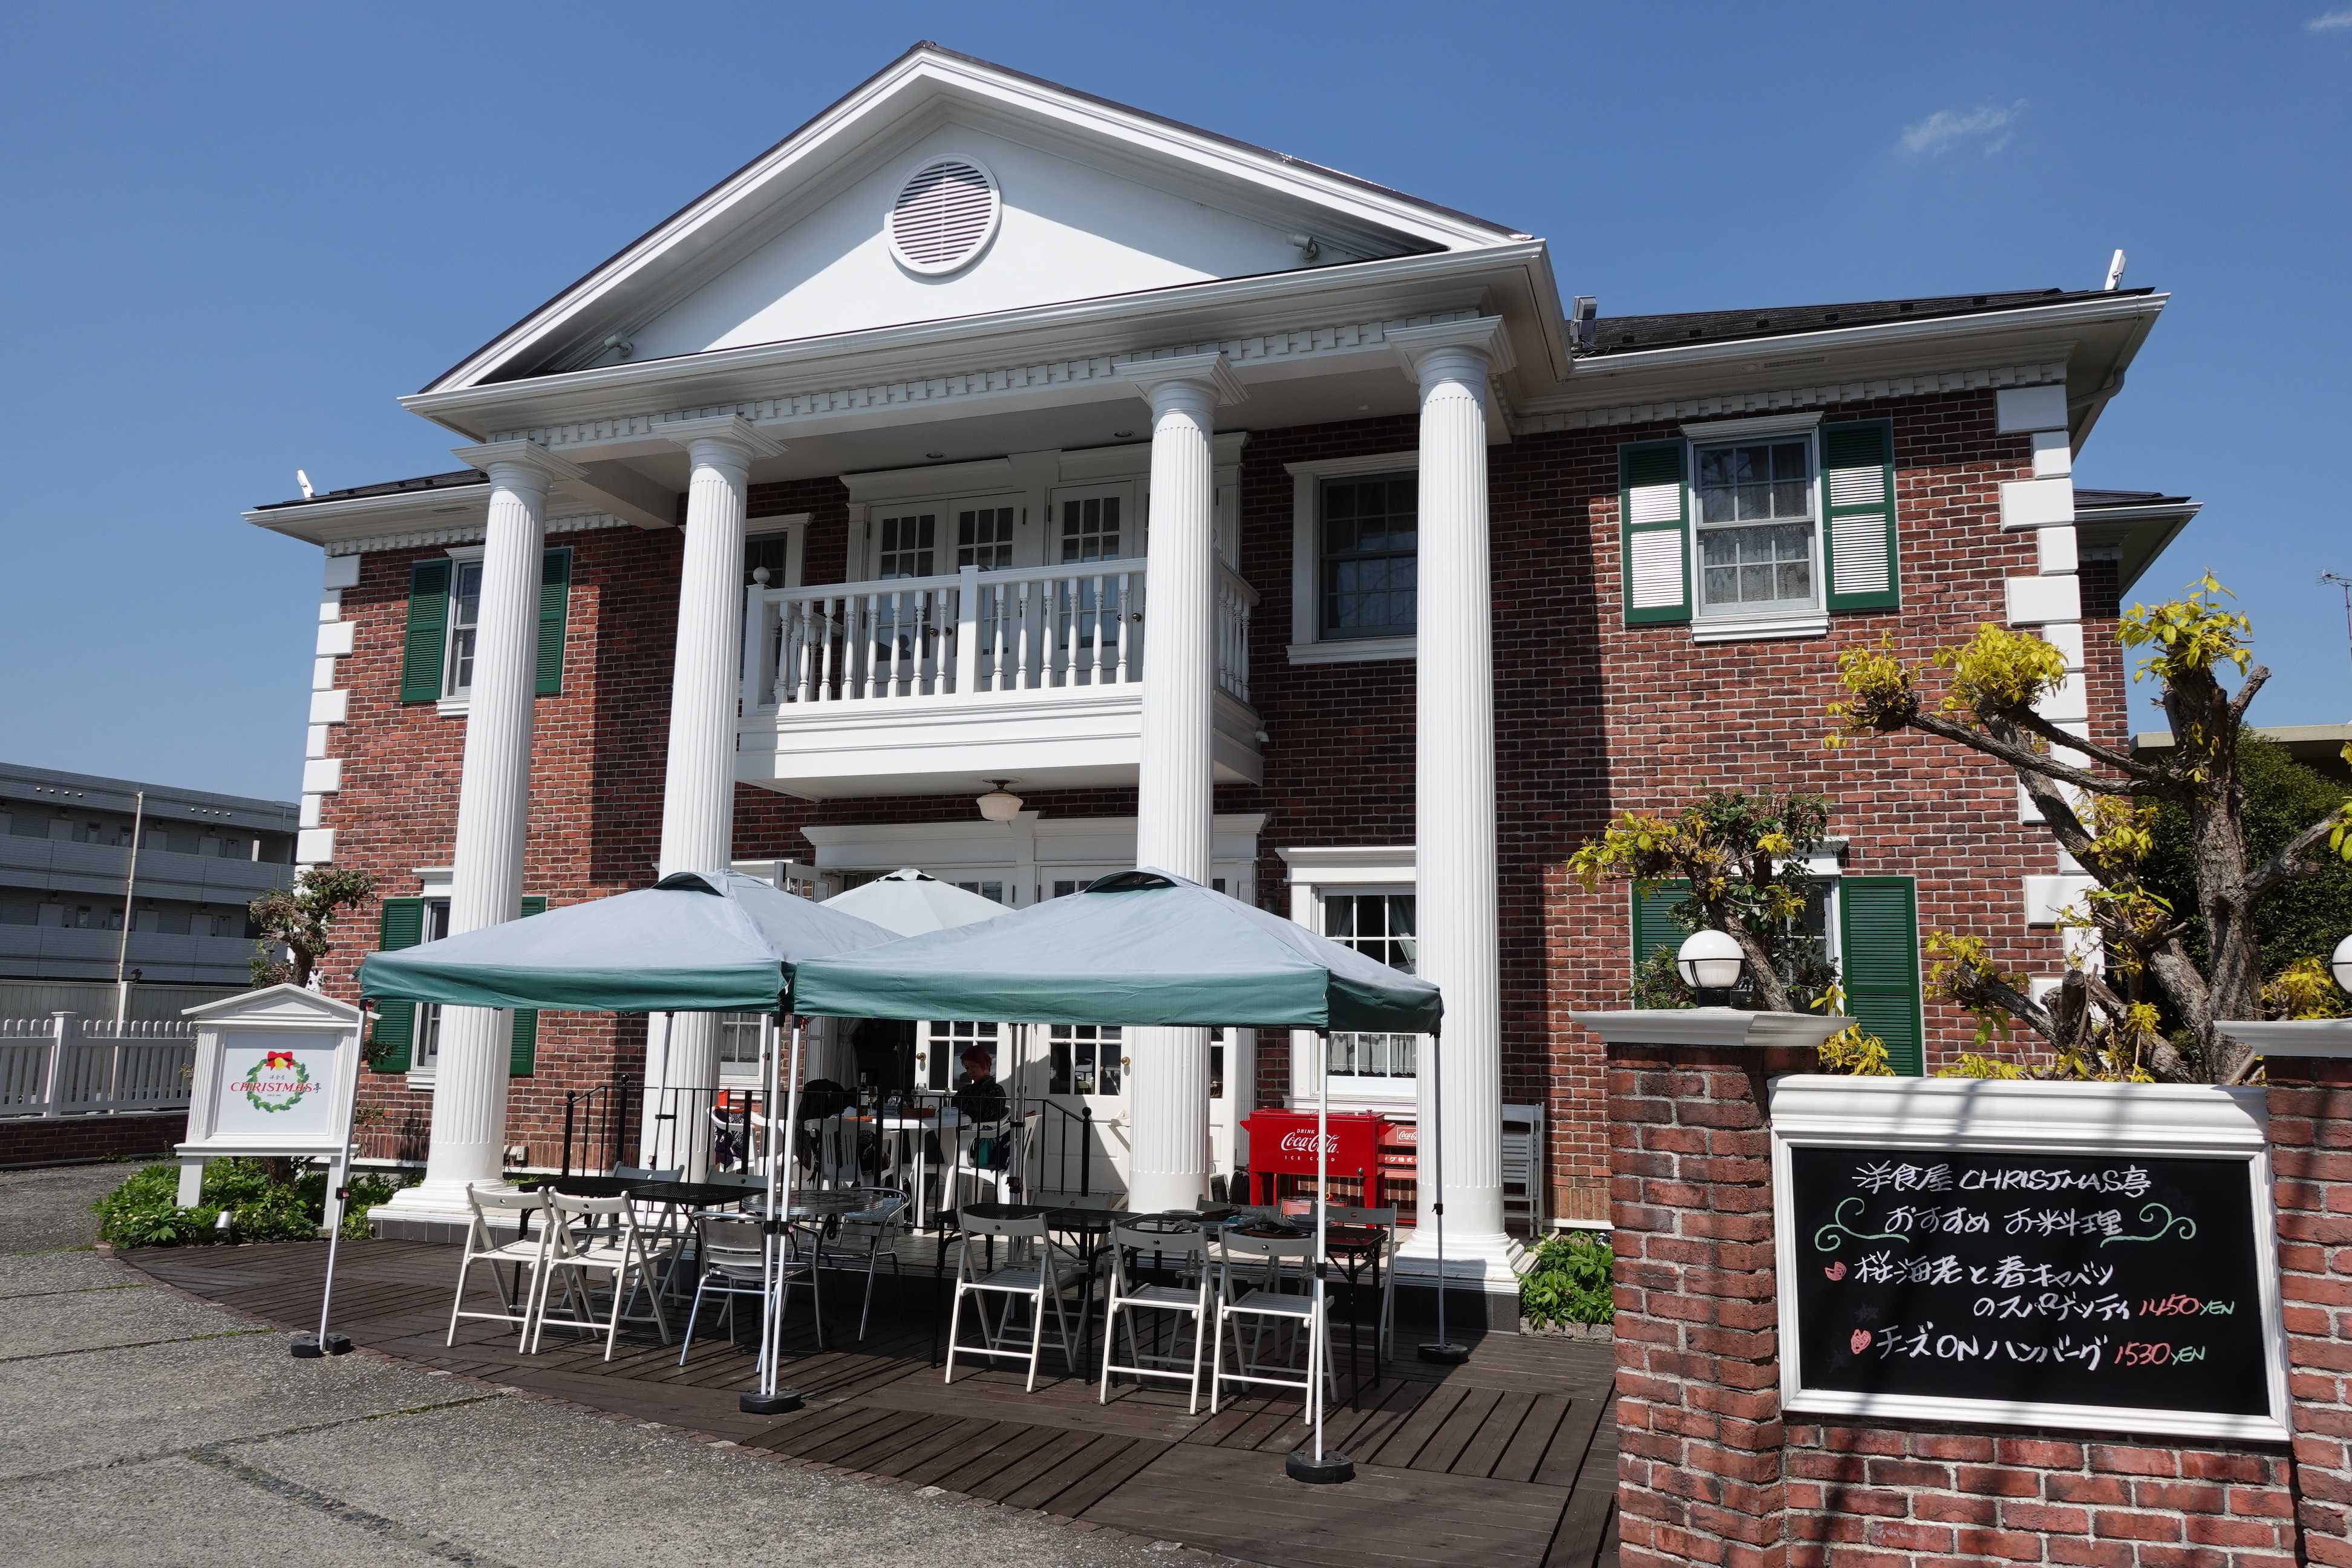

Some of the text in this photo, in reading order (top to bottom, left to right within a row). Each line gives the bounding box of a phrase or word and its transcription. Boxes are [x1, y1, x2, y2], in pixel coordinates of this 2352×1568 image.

[1851, 1160, 1953, 1194] 洋食屋
[1884, 1205, 2125, 1237] おすすめ お料理
